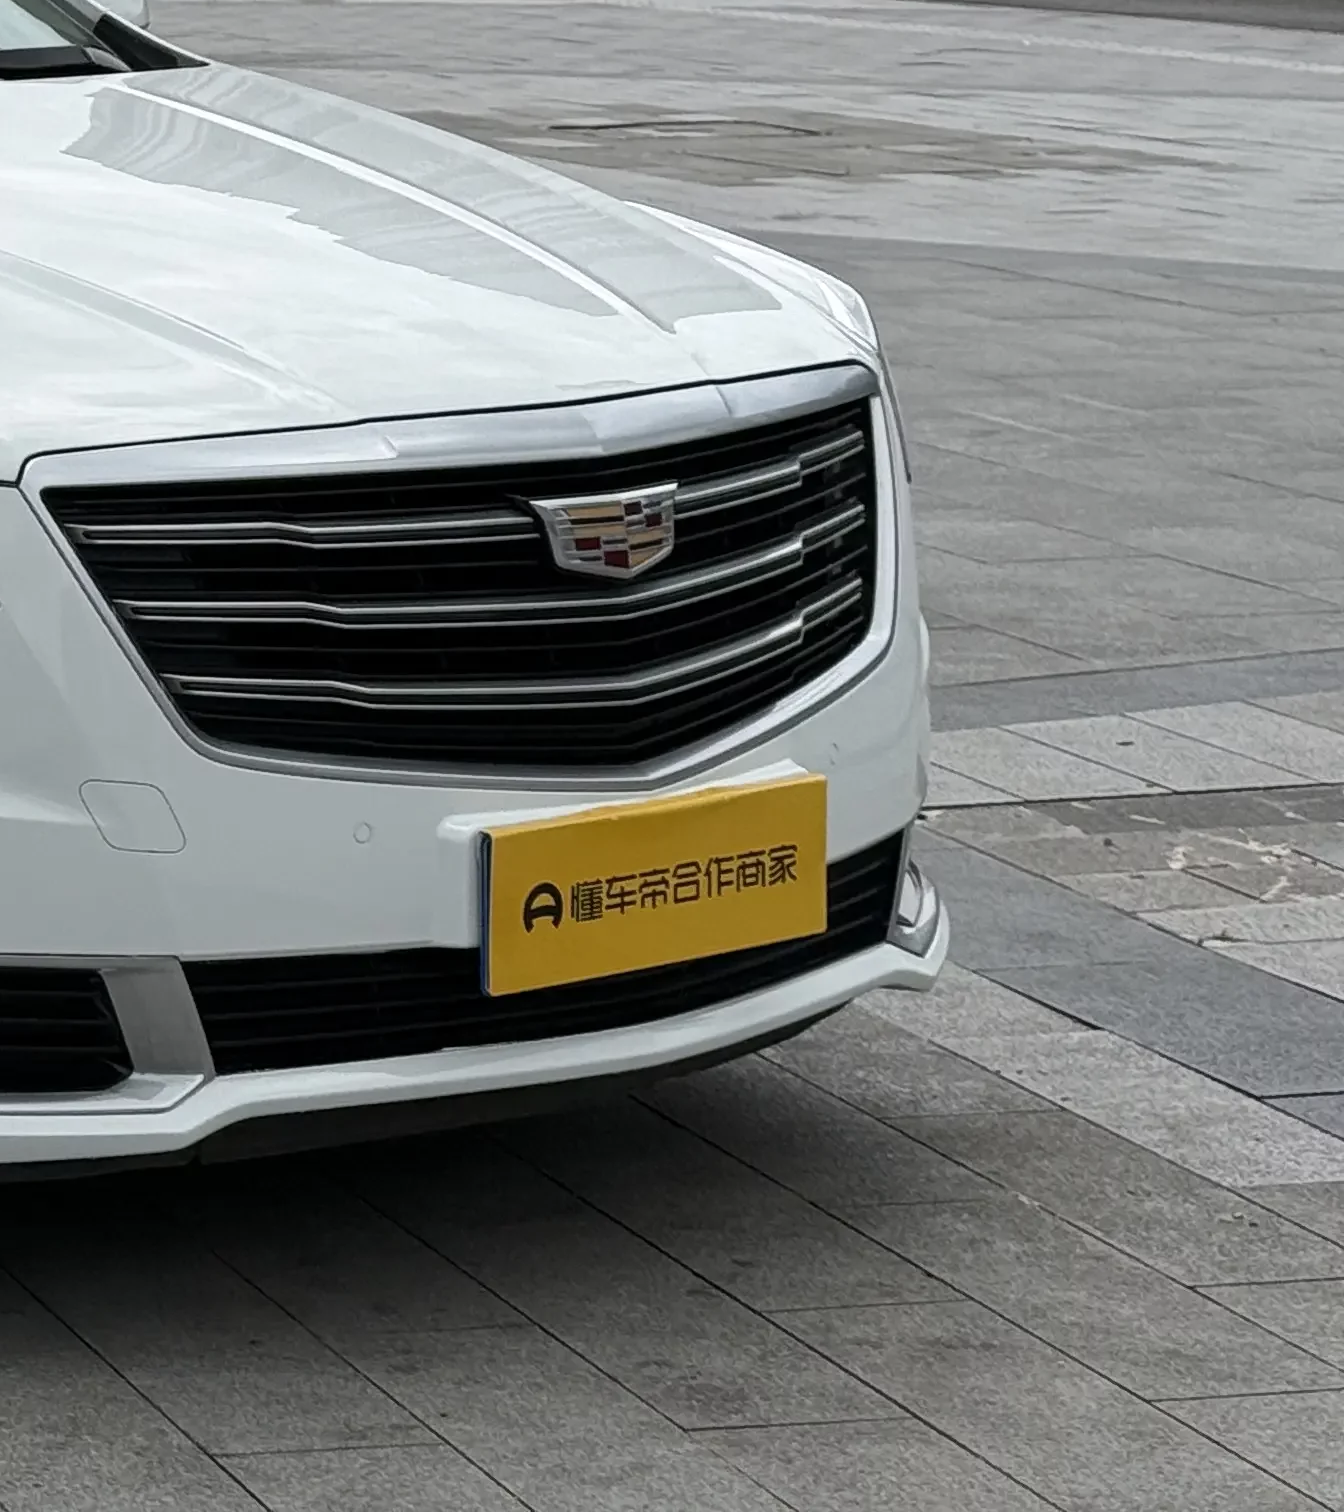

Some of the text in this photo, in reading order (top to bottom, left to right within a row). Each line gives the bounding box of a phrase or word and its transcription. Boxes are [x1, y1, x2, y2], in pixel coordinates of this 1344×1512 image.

[570, 843, 799, 923] 懂车帝合作商家
